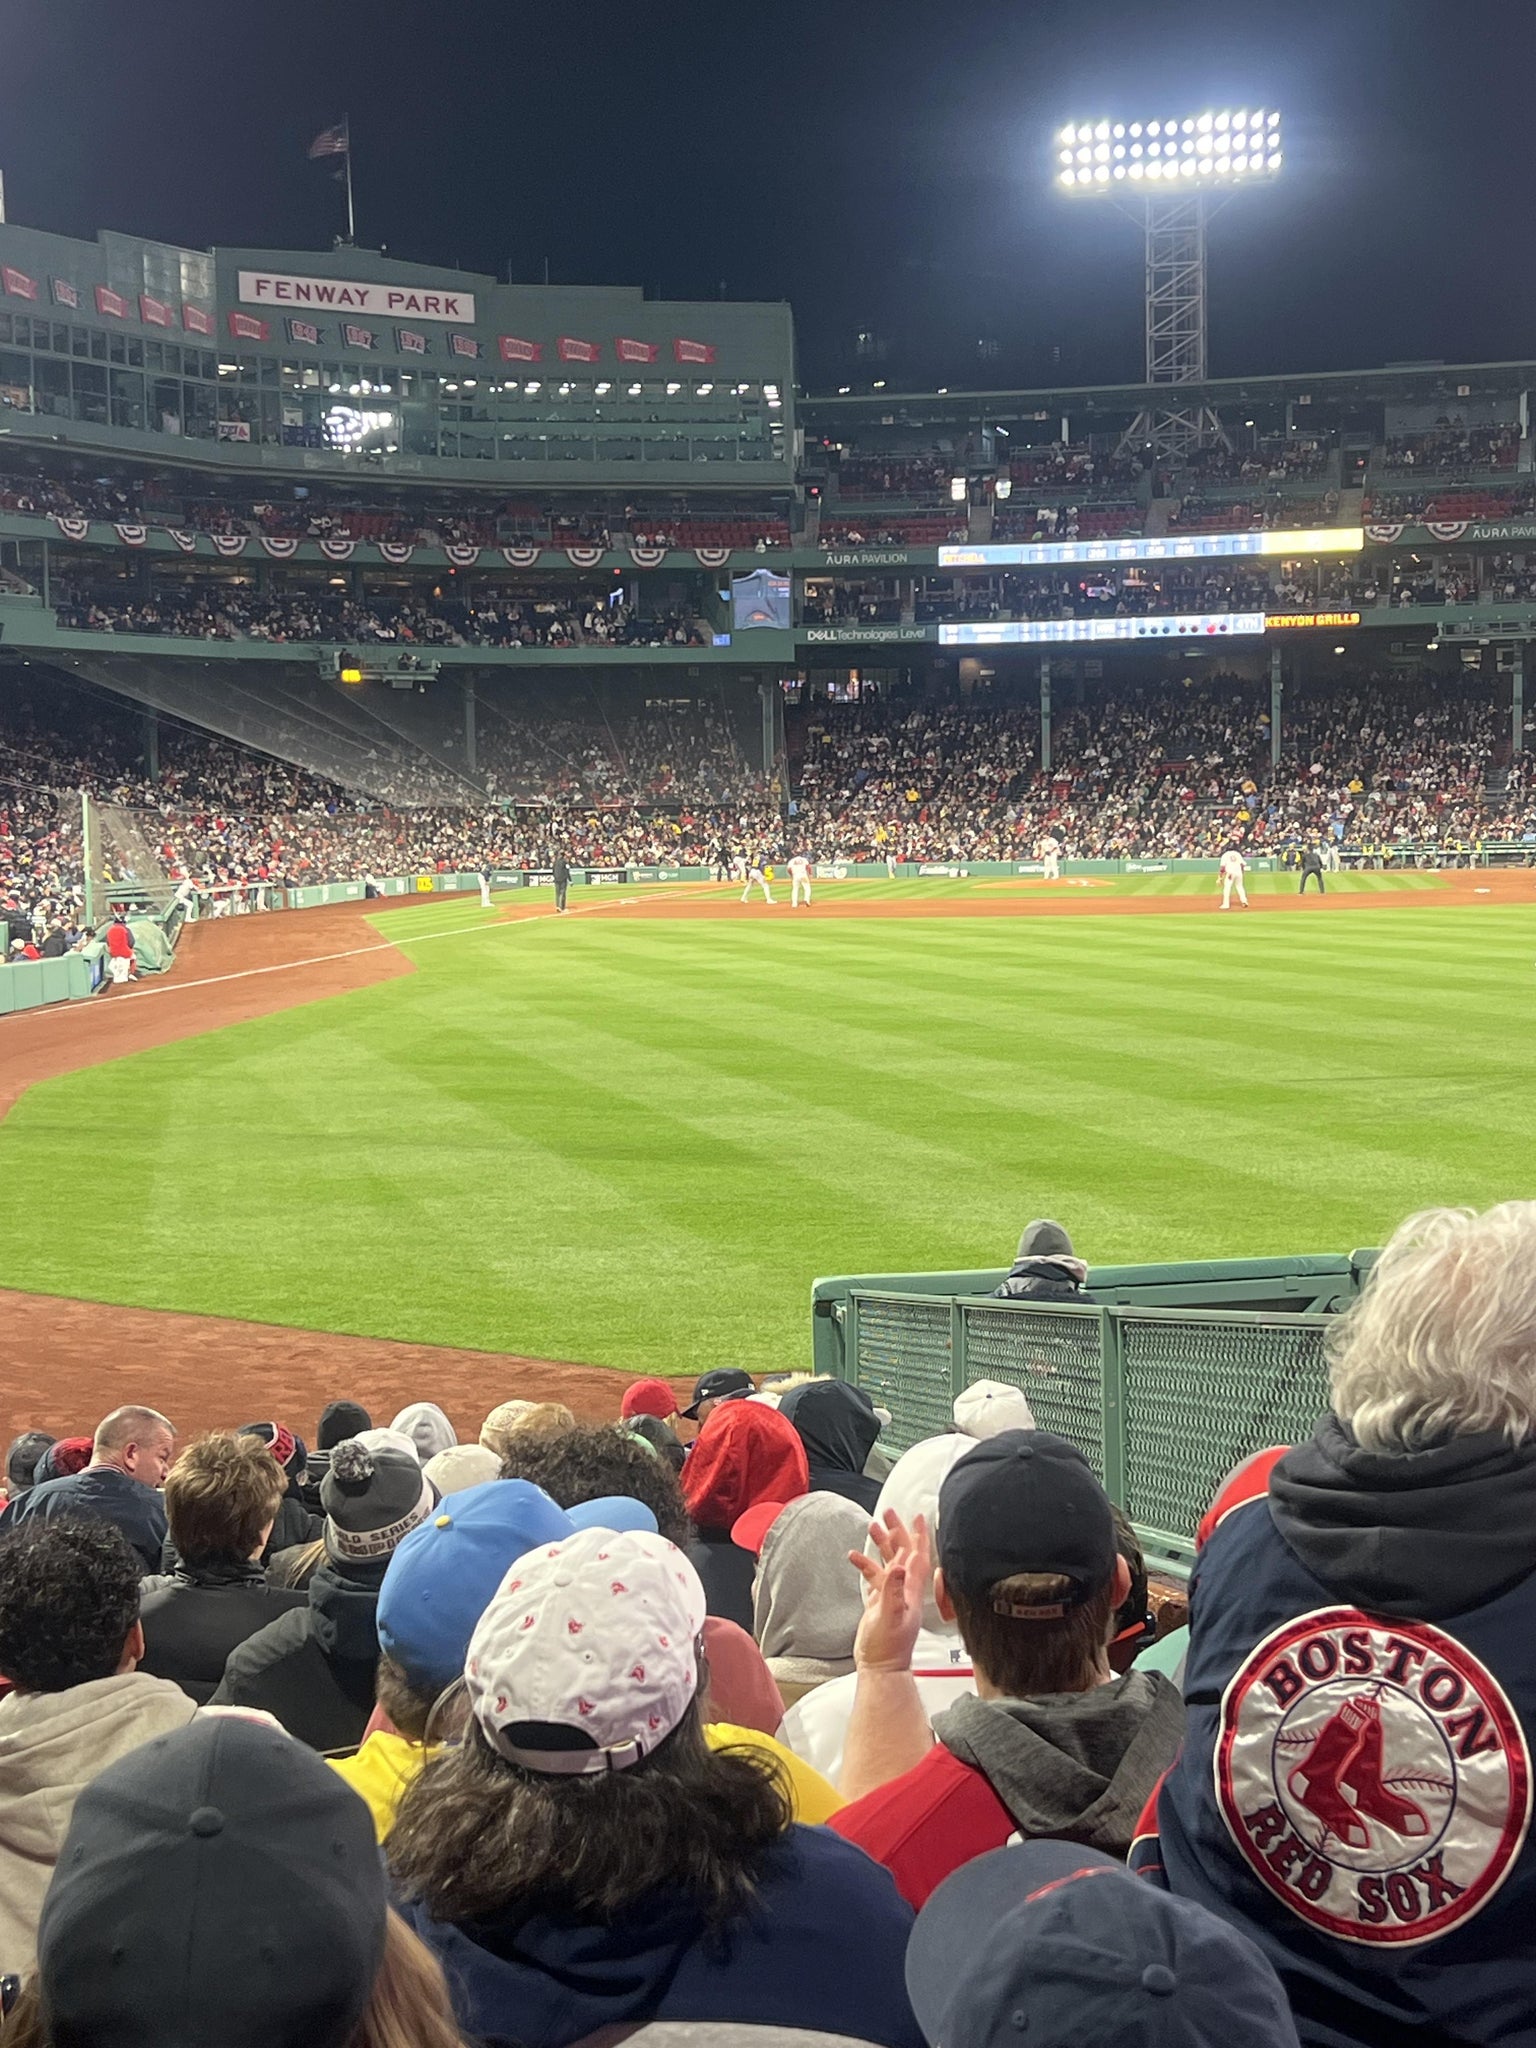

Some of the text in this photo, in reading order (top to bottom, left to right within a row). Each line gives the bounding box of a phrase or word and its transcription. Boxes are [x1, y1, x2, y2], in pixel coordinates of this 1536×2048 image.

[255, 279, 460, 315] FENWAY PARK
[861, 553, 908, 564] PAVILION
[807, 628, 926, 642] DELL Technologies Level
[1265, 614, 1314, 628] KENYON
[370, 1512, 419, 1542] SERIES
[1262, 1631, 1504, 1760] BOSTON
[1244, 1801, 1469, 1924] RED SOX
